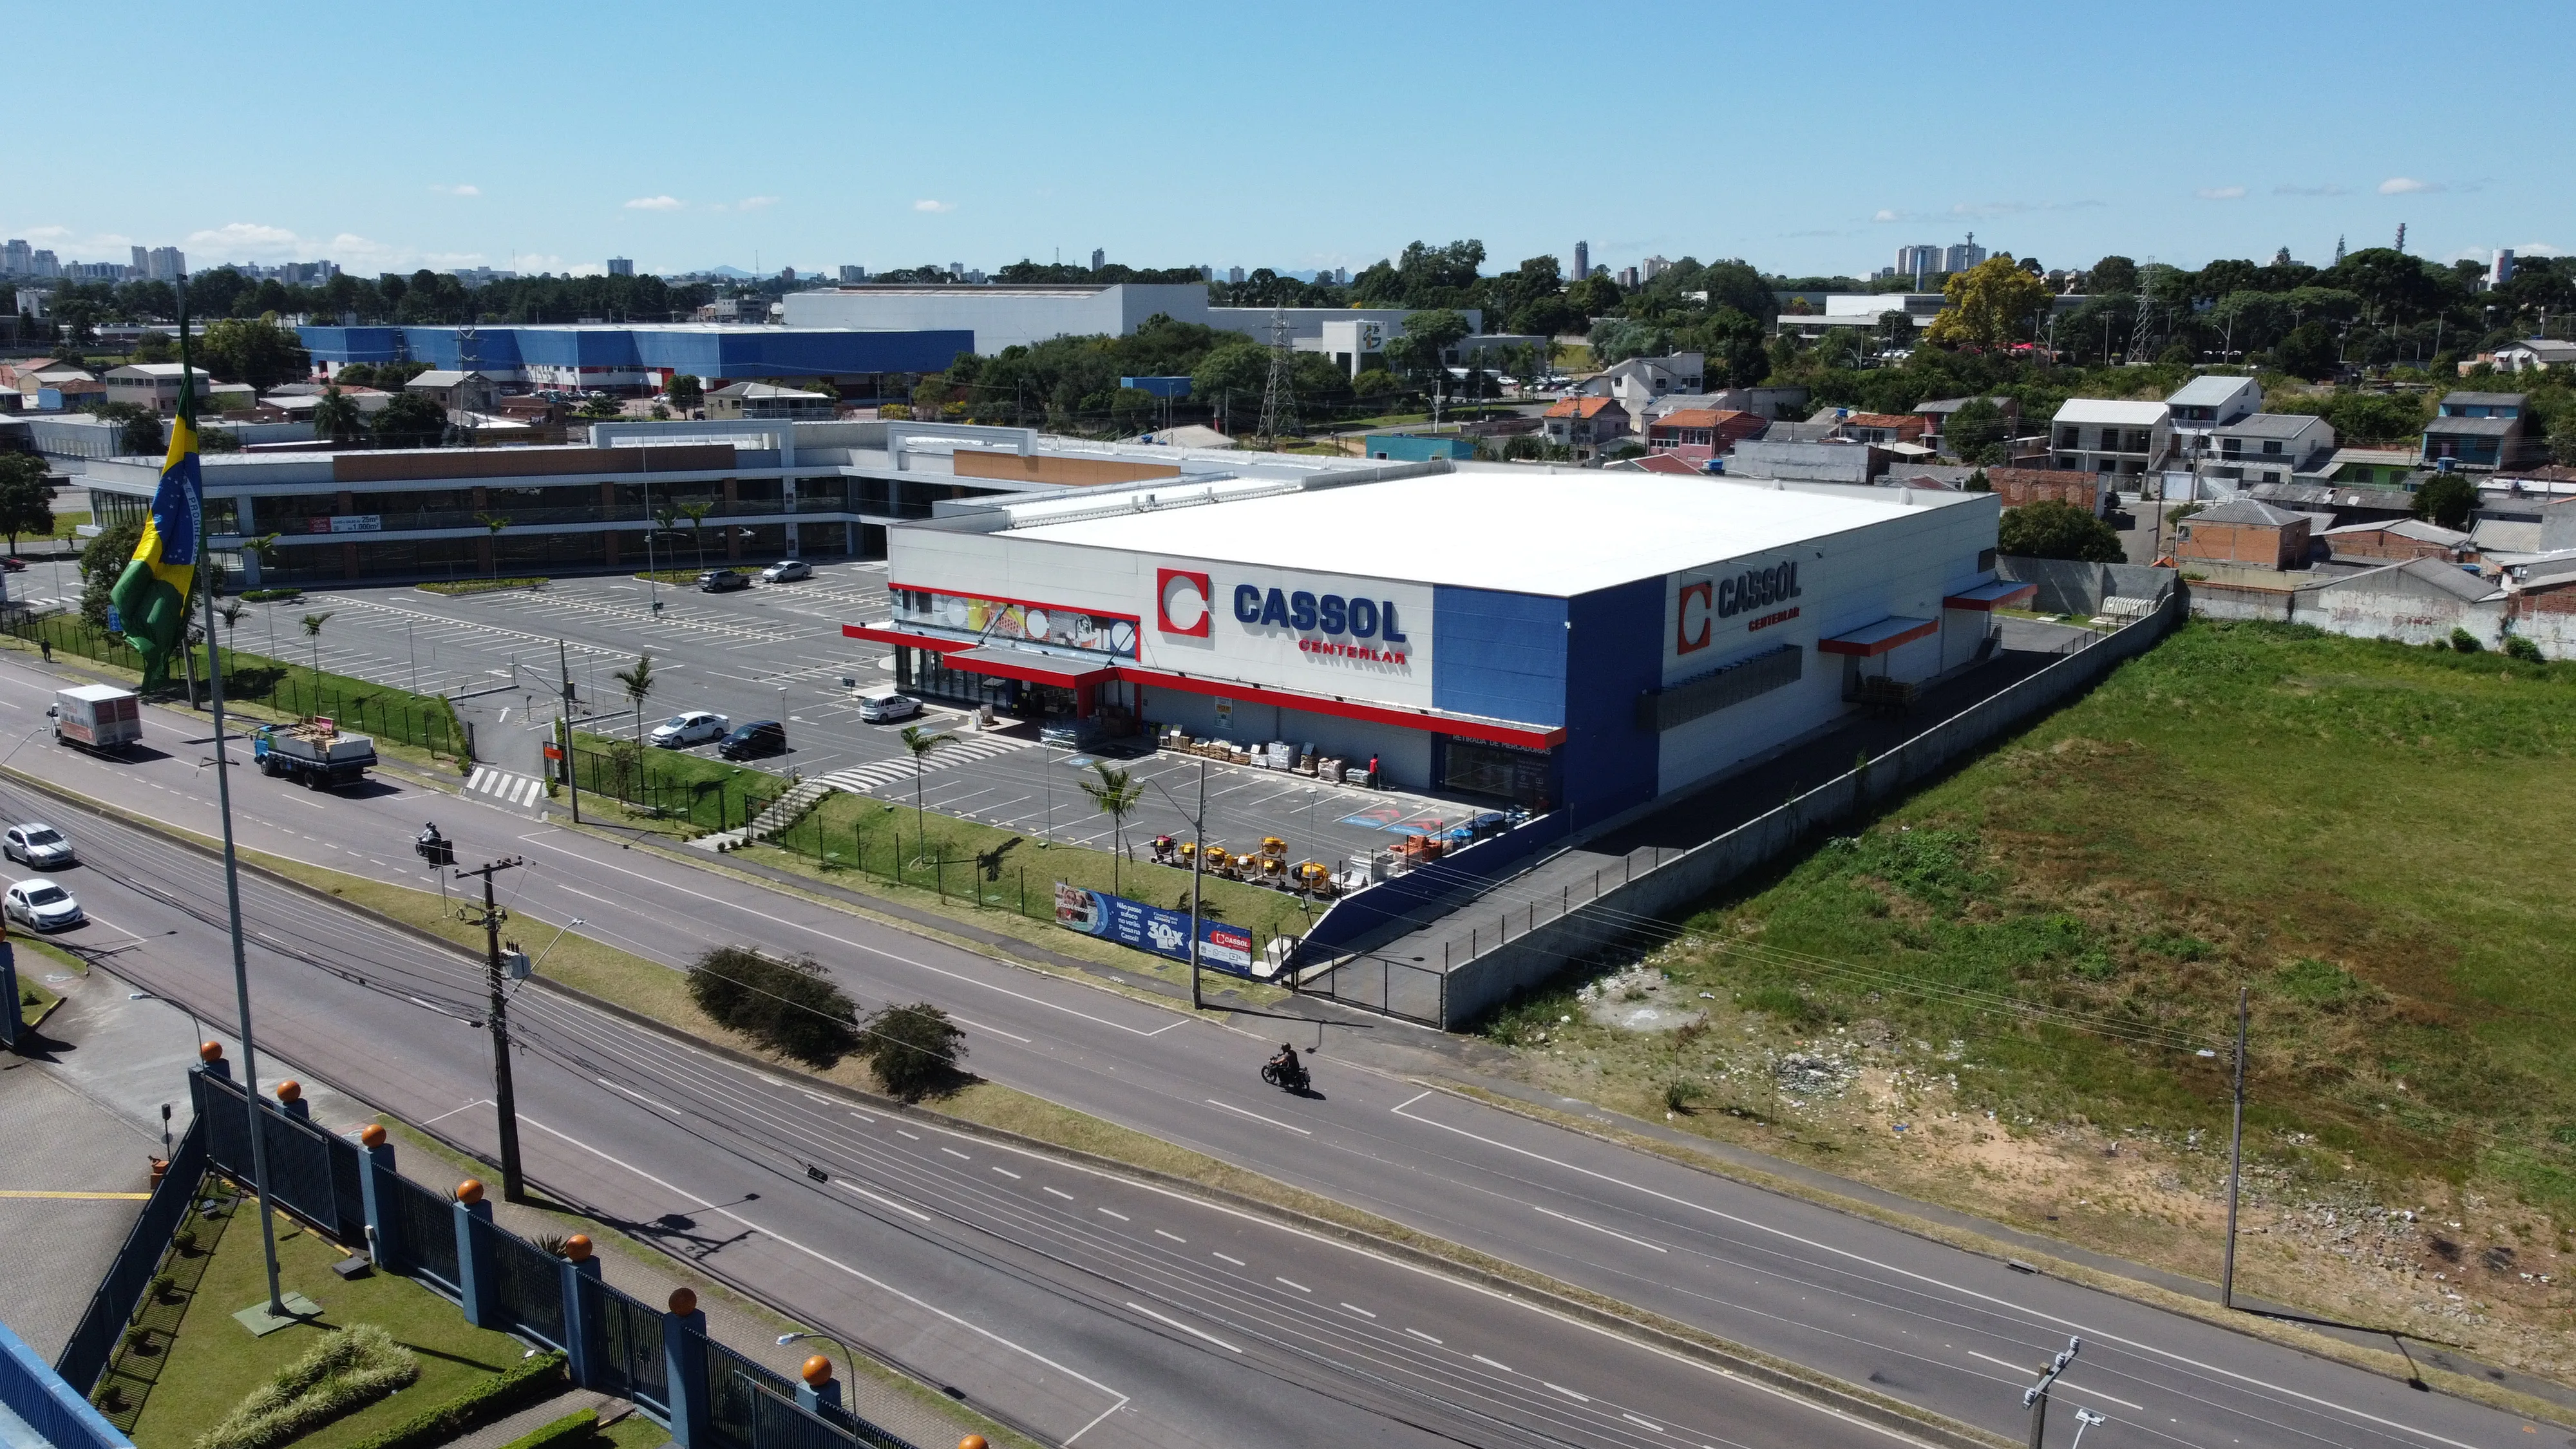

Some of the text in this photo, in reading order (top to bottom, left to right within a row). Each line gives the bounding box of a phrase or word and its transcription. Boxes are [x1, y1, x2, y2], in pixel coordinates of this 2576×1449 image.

[1718, 561, 1802, 618] CASSOL
[1233, 583, 1406, 643] CASSOL
[1748, 607, 1800, 632] CENTERLAR
[1298, 639, 1406, 665] CENTERLAR
[1117, 902, 1127, 910] Não
[1121, 911, 1139, 920] sufoco
[1119, 924, 1133, 933] Passa
[1121, 932, 1139, 942] Cassol!
[1147, 920, 1184, 946] 30x
[1224, 936, 1249, 947] CASSOL
